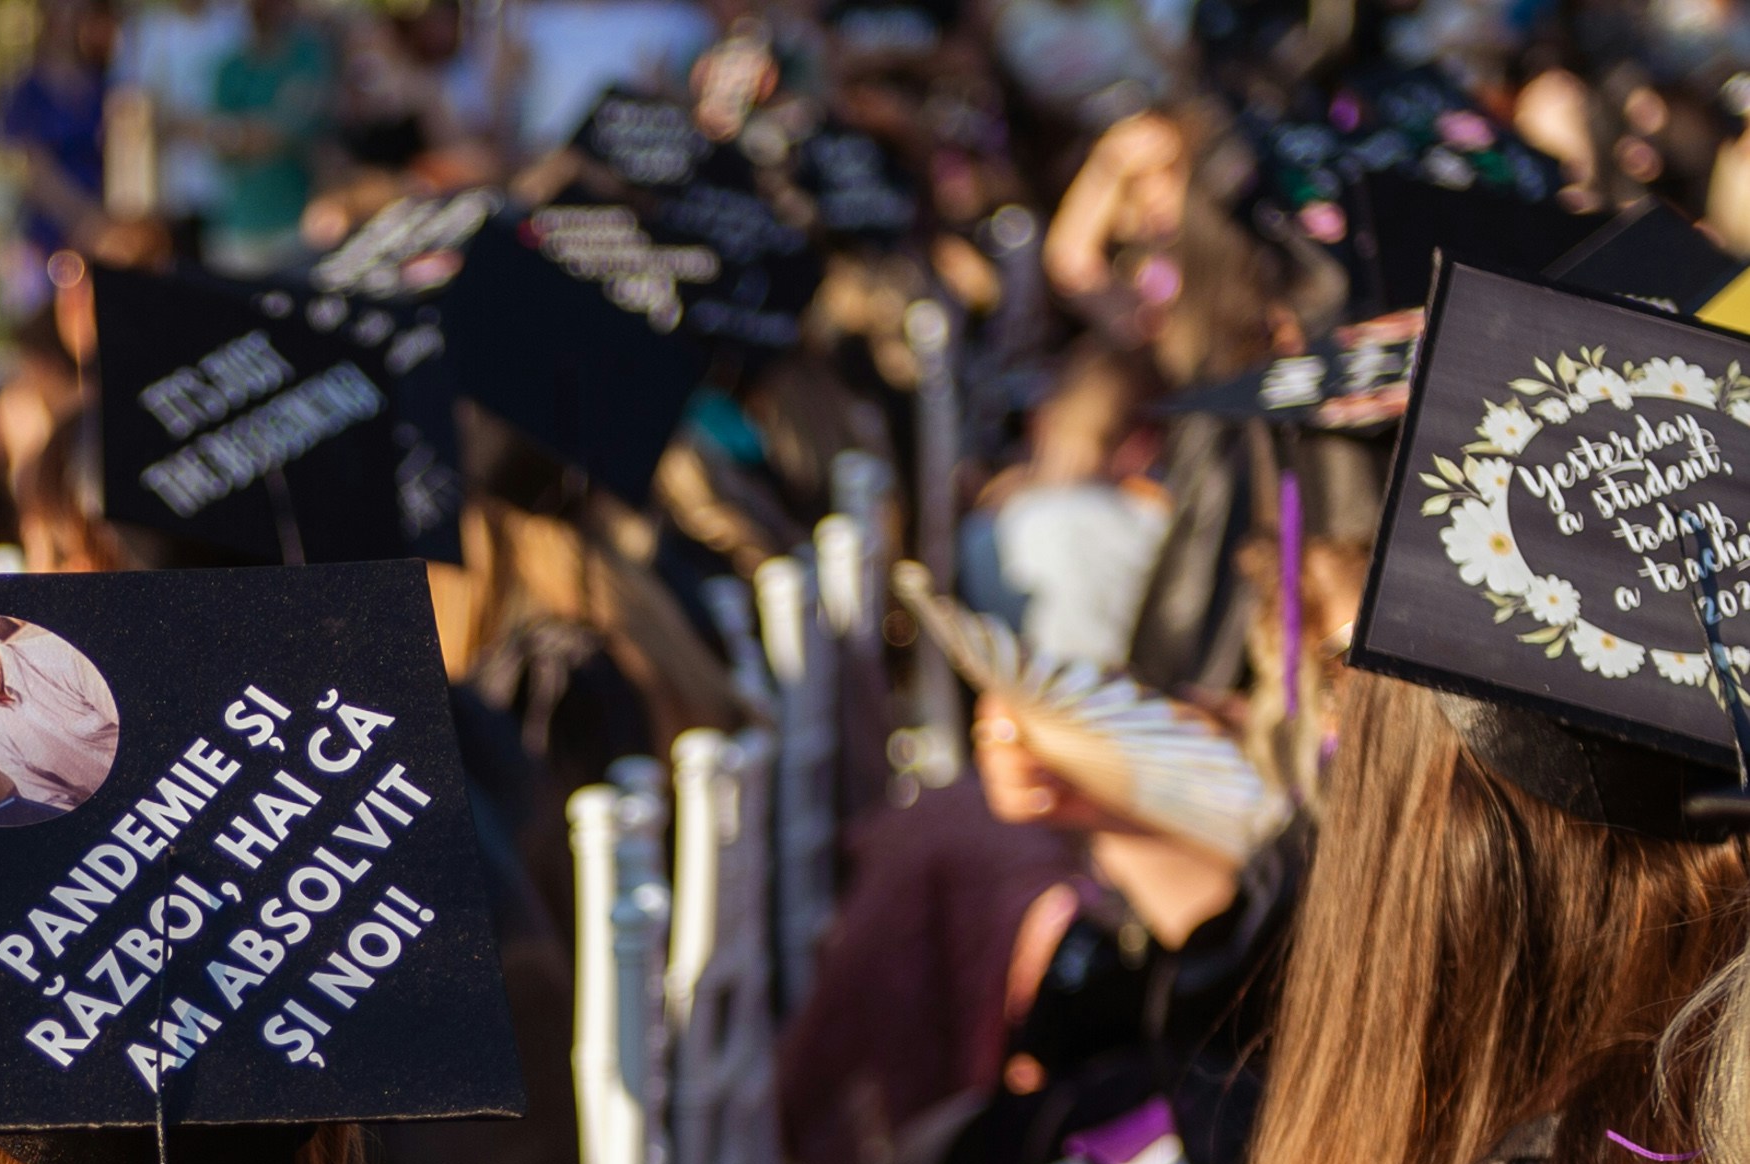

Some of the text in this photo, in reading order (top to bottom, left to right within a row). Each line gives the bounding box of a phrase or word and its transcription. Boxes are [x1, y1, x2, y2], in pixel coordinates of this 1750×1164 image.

[1557, 444, 1734, 536] a student,
[1612, 501, 1738, 554] today
[1614, 522, 1750, 612] a teache
[223, 683, 293, 753] ȘI
[24, 687, 397, 1069] RĂZBOI, HAI CĂ
[125, 762, 433, 1095] AM ABSOLVIT
[262, 884, 435, 1070] ȘI NOI!
